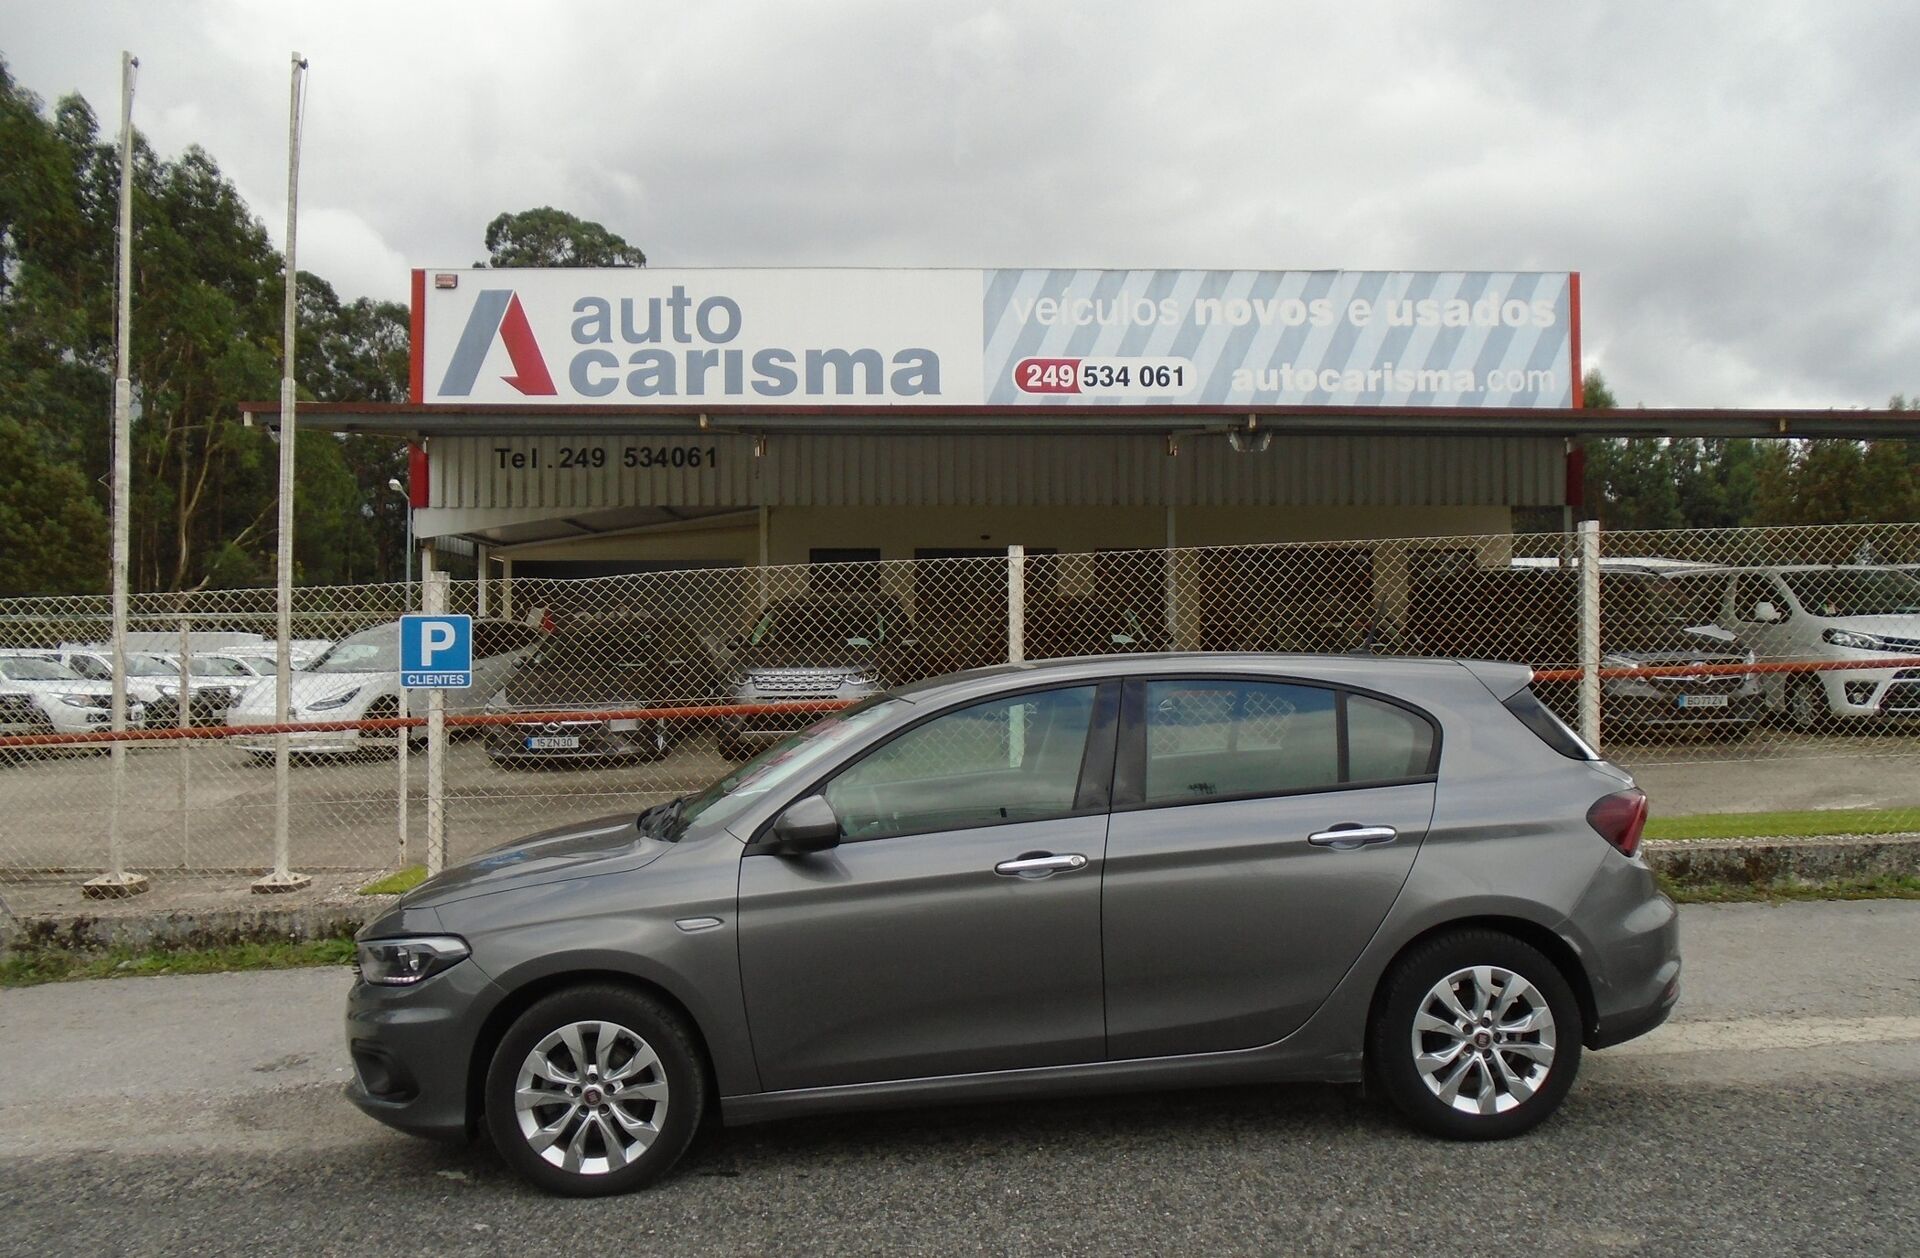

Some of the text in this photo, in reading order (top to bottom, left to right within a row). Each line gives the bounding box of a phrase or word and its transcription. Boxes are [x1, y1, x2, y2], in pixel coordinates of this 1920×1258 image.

[570, 285, 742, 344] auto
[1013, 287, 1557, 328] veículos novos e usados
[568, 348, 942, 398] carisma
[1026, 364, 1184, 388] 249 534 061
[1231, 361, 1556, 393] autocarisma.com
[623, 446, 717, 468] 534061
[421, 621, 456, 667] P
[407, 674, 465, 685] CLIENTES
